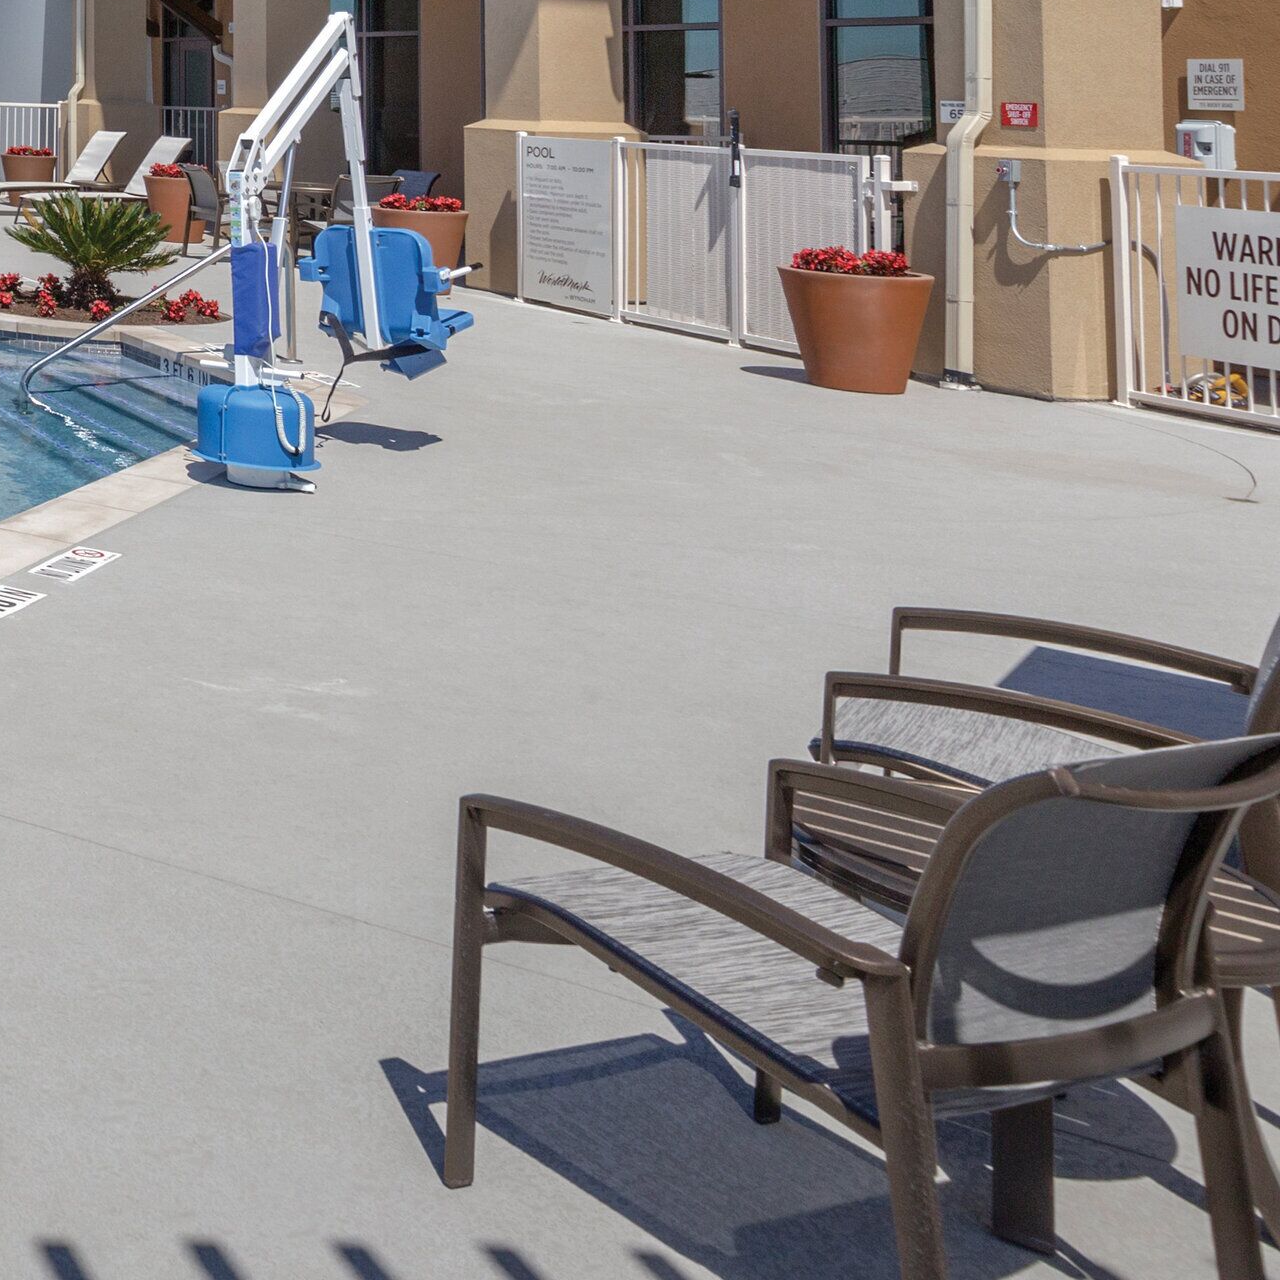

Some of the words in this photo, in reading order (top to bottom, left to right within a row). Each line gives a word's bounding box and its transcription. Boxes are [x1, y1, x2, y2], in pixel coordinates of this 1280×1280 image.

[1199, 63, 1215, 73] DIAL
[1218, 63, 1230, 72] 911
[1194, 75, 1203, 84] IN
[1205, 75, 1223, 84] CASE
[1226, 74, 1236, 84] OF
[1193, 86, 1238, 96] EMERGENCY
[1005, 103, 1033, 111] EMERGENCY
[526, 146, 555, 159] POOL
[1212, 231, 1280, 267] WAR
[1186, 266, 1221, 298] NO
[1229, 271, 1279, 306] LIFE
[1222, 309, 1258, 342] ON
[163, 358, 170, 372] 3
[172, 361, 183, 377] FT
[187, 367, 194, 381] 6
[198, 370, 208, 387] IN
